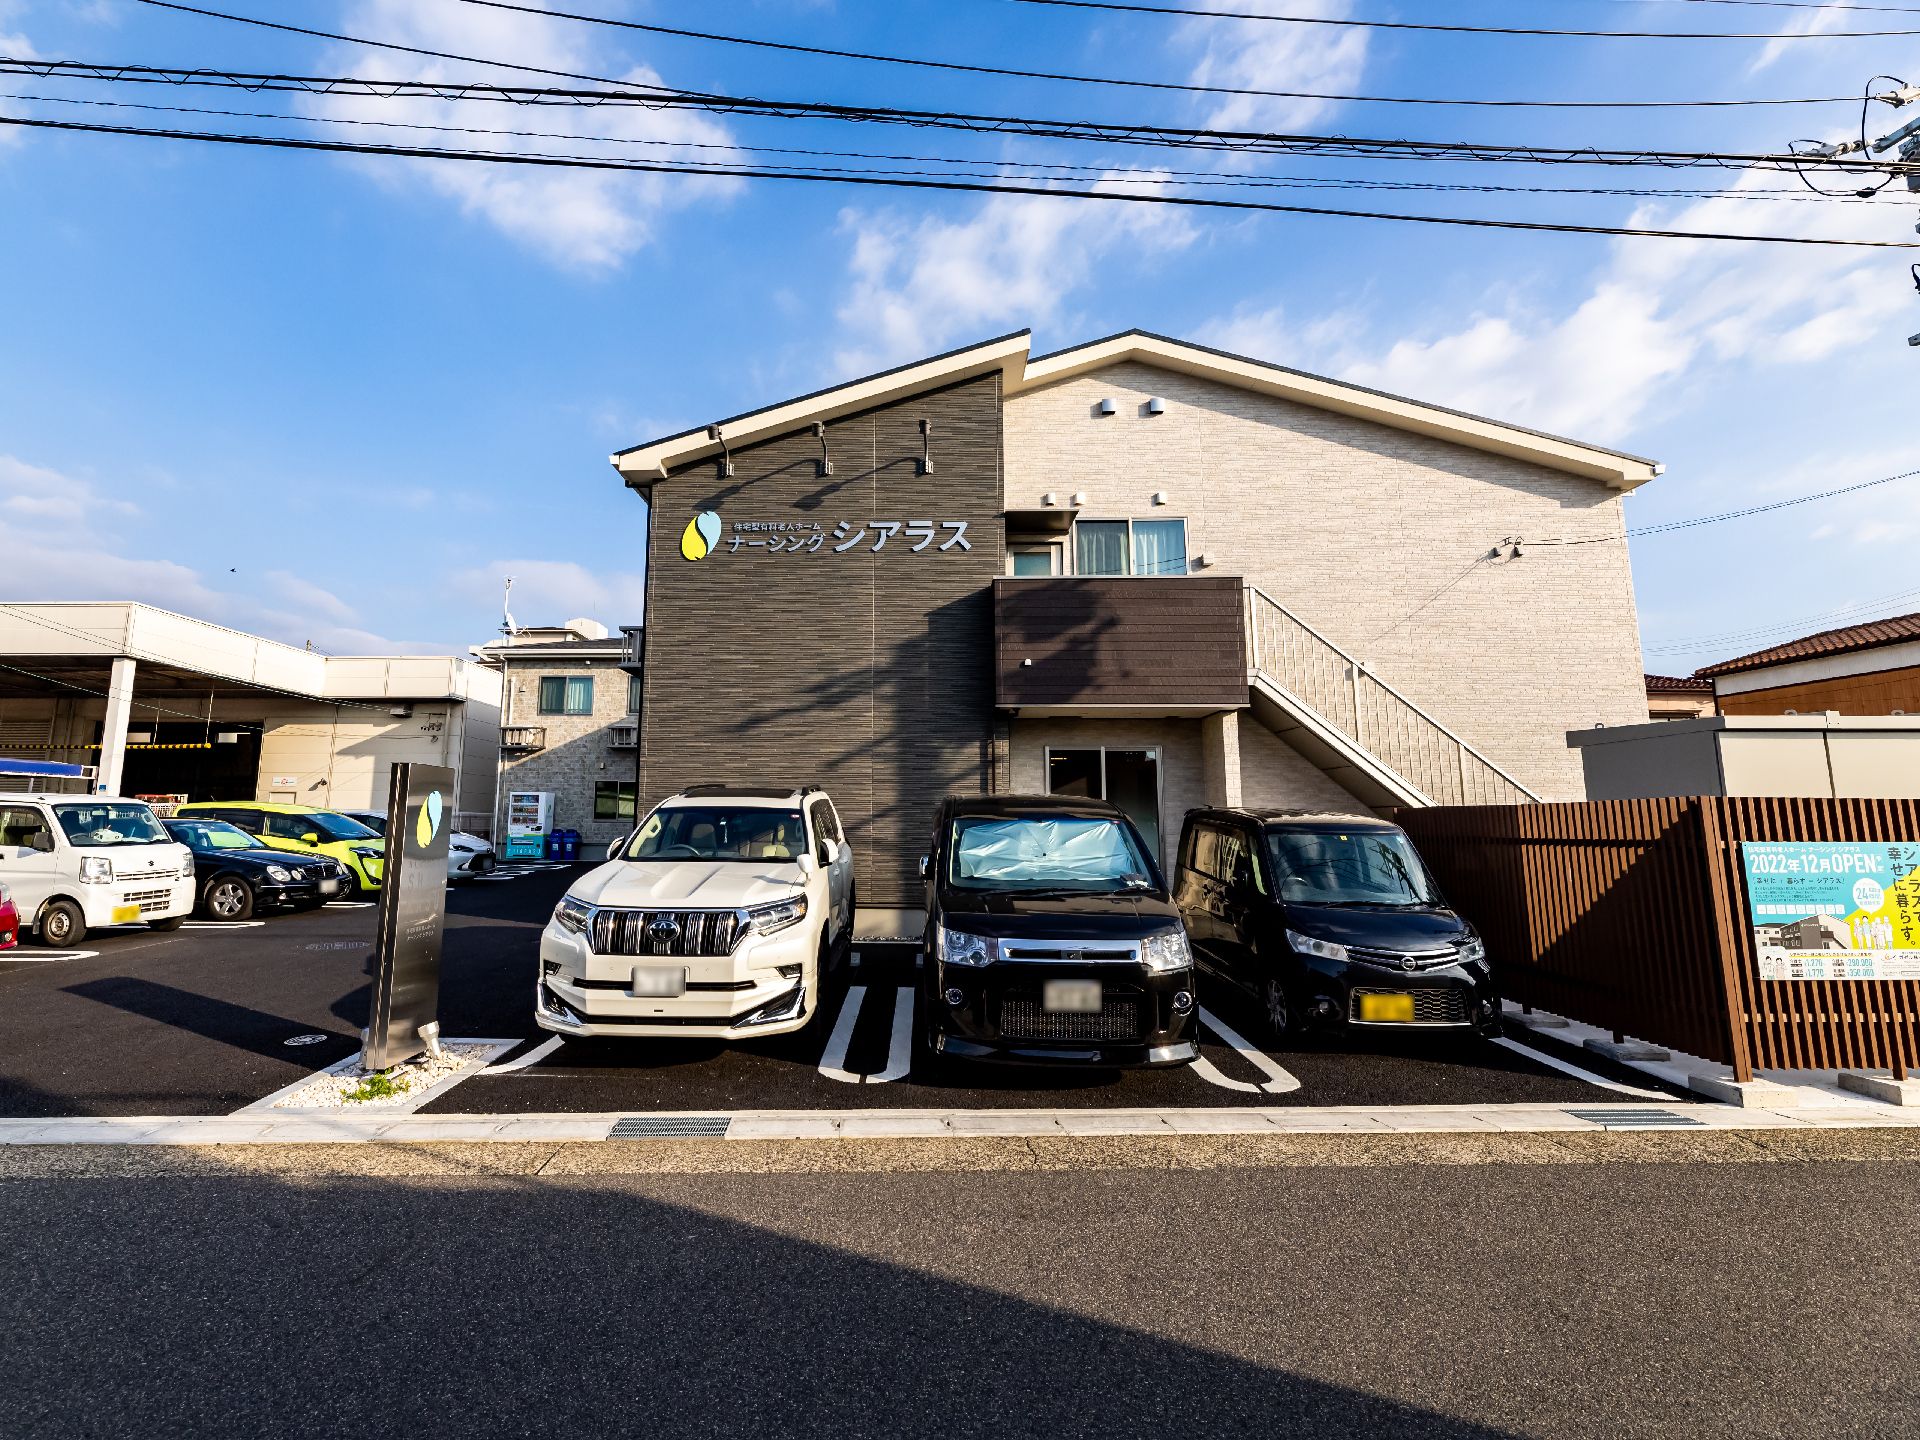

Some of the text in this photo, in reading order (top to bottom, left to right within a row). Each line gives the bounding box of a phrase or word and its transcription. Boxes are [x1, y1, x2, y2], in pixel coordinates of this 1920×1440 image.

[727, 520, 972, 553] ナーシング シアラス
[734, 522, 820, 531] 住宅型有料老人ホーム
[1855, 887, 1868, 900] 24
[1887, 846, 1916, 945] 幸せに暮らす。
